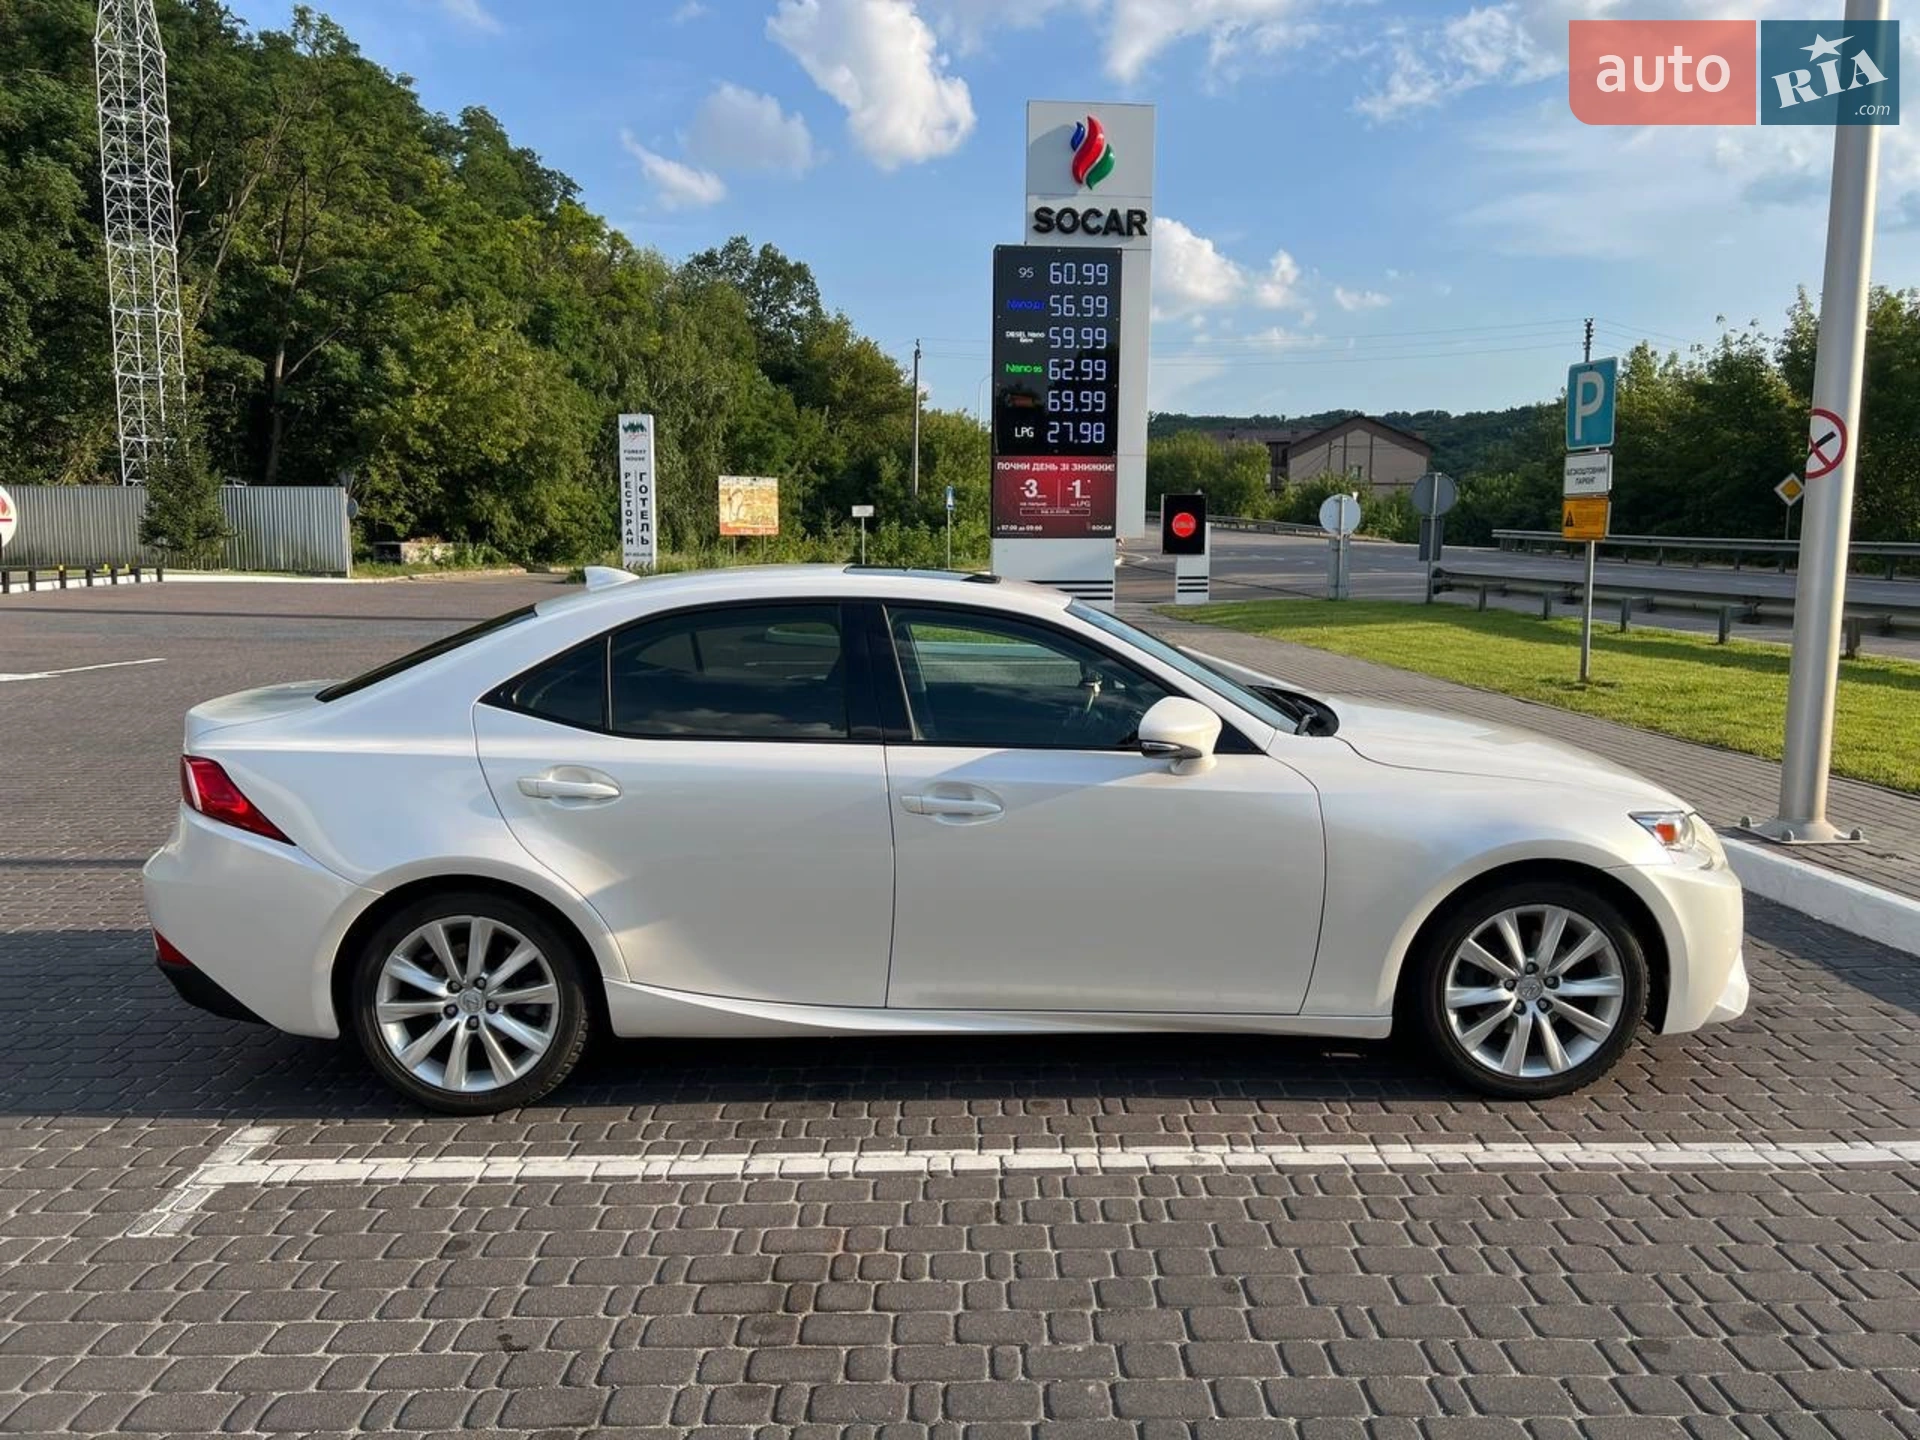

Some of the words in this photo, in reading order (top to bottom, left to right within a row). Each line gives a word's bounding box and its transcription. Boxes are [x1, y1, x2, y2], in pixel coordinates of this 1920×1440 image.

[1033, 206, 1148, 236] SOCAR
[1018, 267, 1034, 278] 95
[1050, 262, 1108, 285] 60.99
[1049, 295, 1108, 317] 56.99
[1005, 330, 1027, 338] DIESEL
[1049, 326, 1107, 348] 59.99
[1005, 363, 1033, 373] Nano
[1048, 358, 1106, 380] 62.99
[1048, 390, 1106, 412] 69.99
[1574, 371, 1605, 441] P
[1014, 426, 1035, 438] LPG
[1047, 421, 1105, 443] 27.98
[997, 461, 1030, 471] ПОЧНИ
[1031, 462, 1059, 471] ДЕНЬ
[624, 472, 634, 546] РЕСТОРАН
[638, 471, 650, 546] ГОТЕЛЬ
